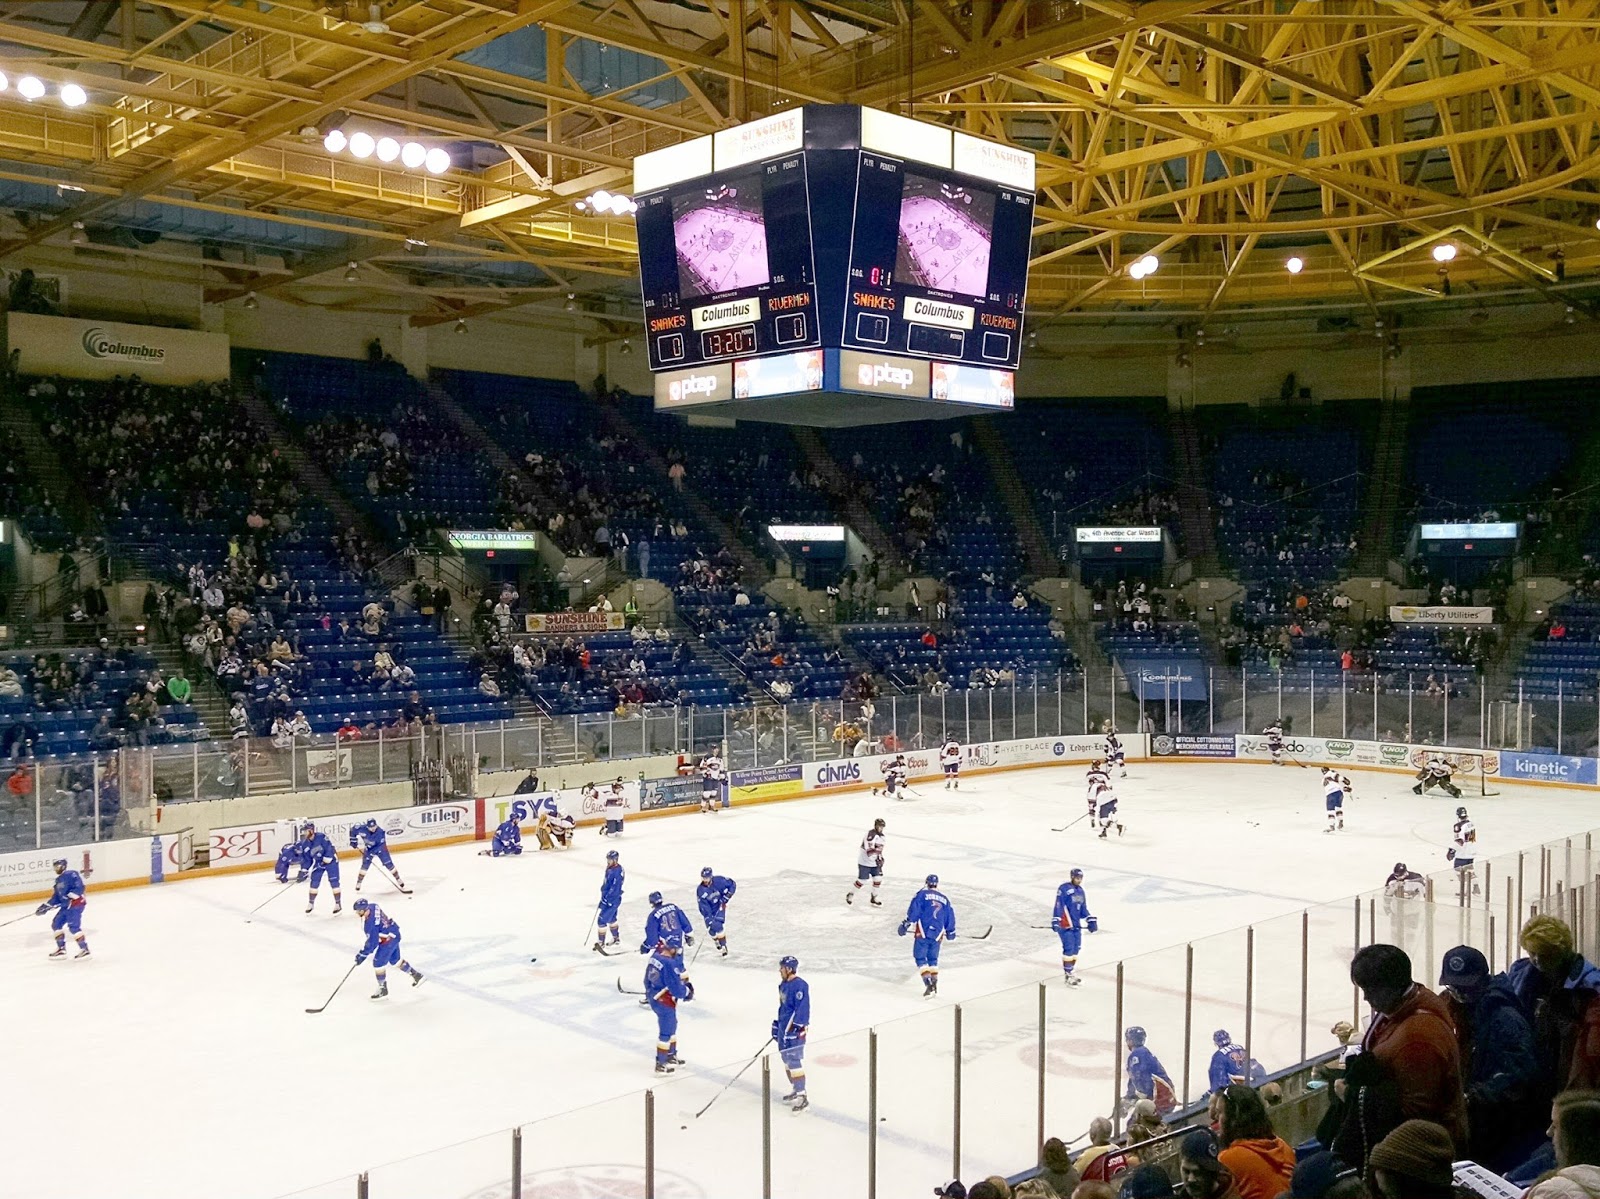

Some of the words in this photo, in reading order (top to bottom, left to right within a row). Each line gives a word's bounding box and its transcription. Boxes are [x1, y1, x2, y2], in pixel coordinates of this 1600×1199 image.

[782, 160, 799, 171] PENALTY
[879, 161, 897, 173] PENALTY
[768, 293, 810, 312] RIVERMEN
[853, 292, 896, 311] SNAKES
[701, 303, 750, 322] Columbus
[914, 301, 965, 321] Columbus
[650, 315, 687, 332] SNAKES
[794, 318, 804, 339] 0
[980, 313, 1017, 331] RIVERMEN
[98, 341, 165, 358] Columbus
[672, 338, 682, 357] 0
[708, 331, 743, 355] 13:20
[449, 533, 485, 541] GEORGIA
[487, 533, 534, 541] BARIATRICS
[545, 612, 608, 625] SUNSHINE
[1418, 611, 1446, 620] Liberty
[1447, 611, 1479, 619] Utilities
[586, 623, 608, 631] SIGNS
[1001, 744, 1024, 754] HYATT
[1025, 741, 1049, 751] PLACE
[1070, 742, 1103, 752] Ledger-En
[1381, 745, 1407, 753] KNOX
[907, 757, 929, 769] Coors
[1515, 759, 1568, 775] kinetic
[421, 808, 460, 824] Riley
[495, 797, 558, 824] TSYS
[931, 900, 942, 920] 7
